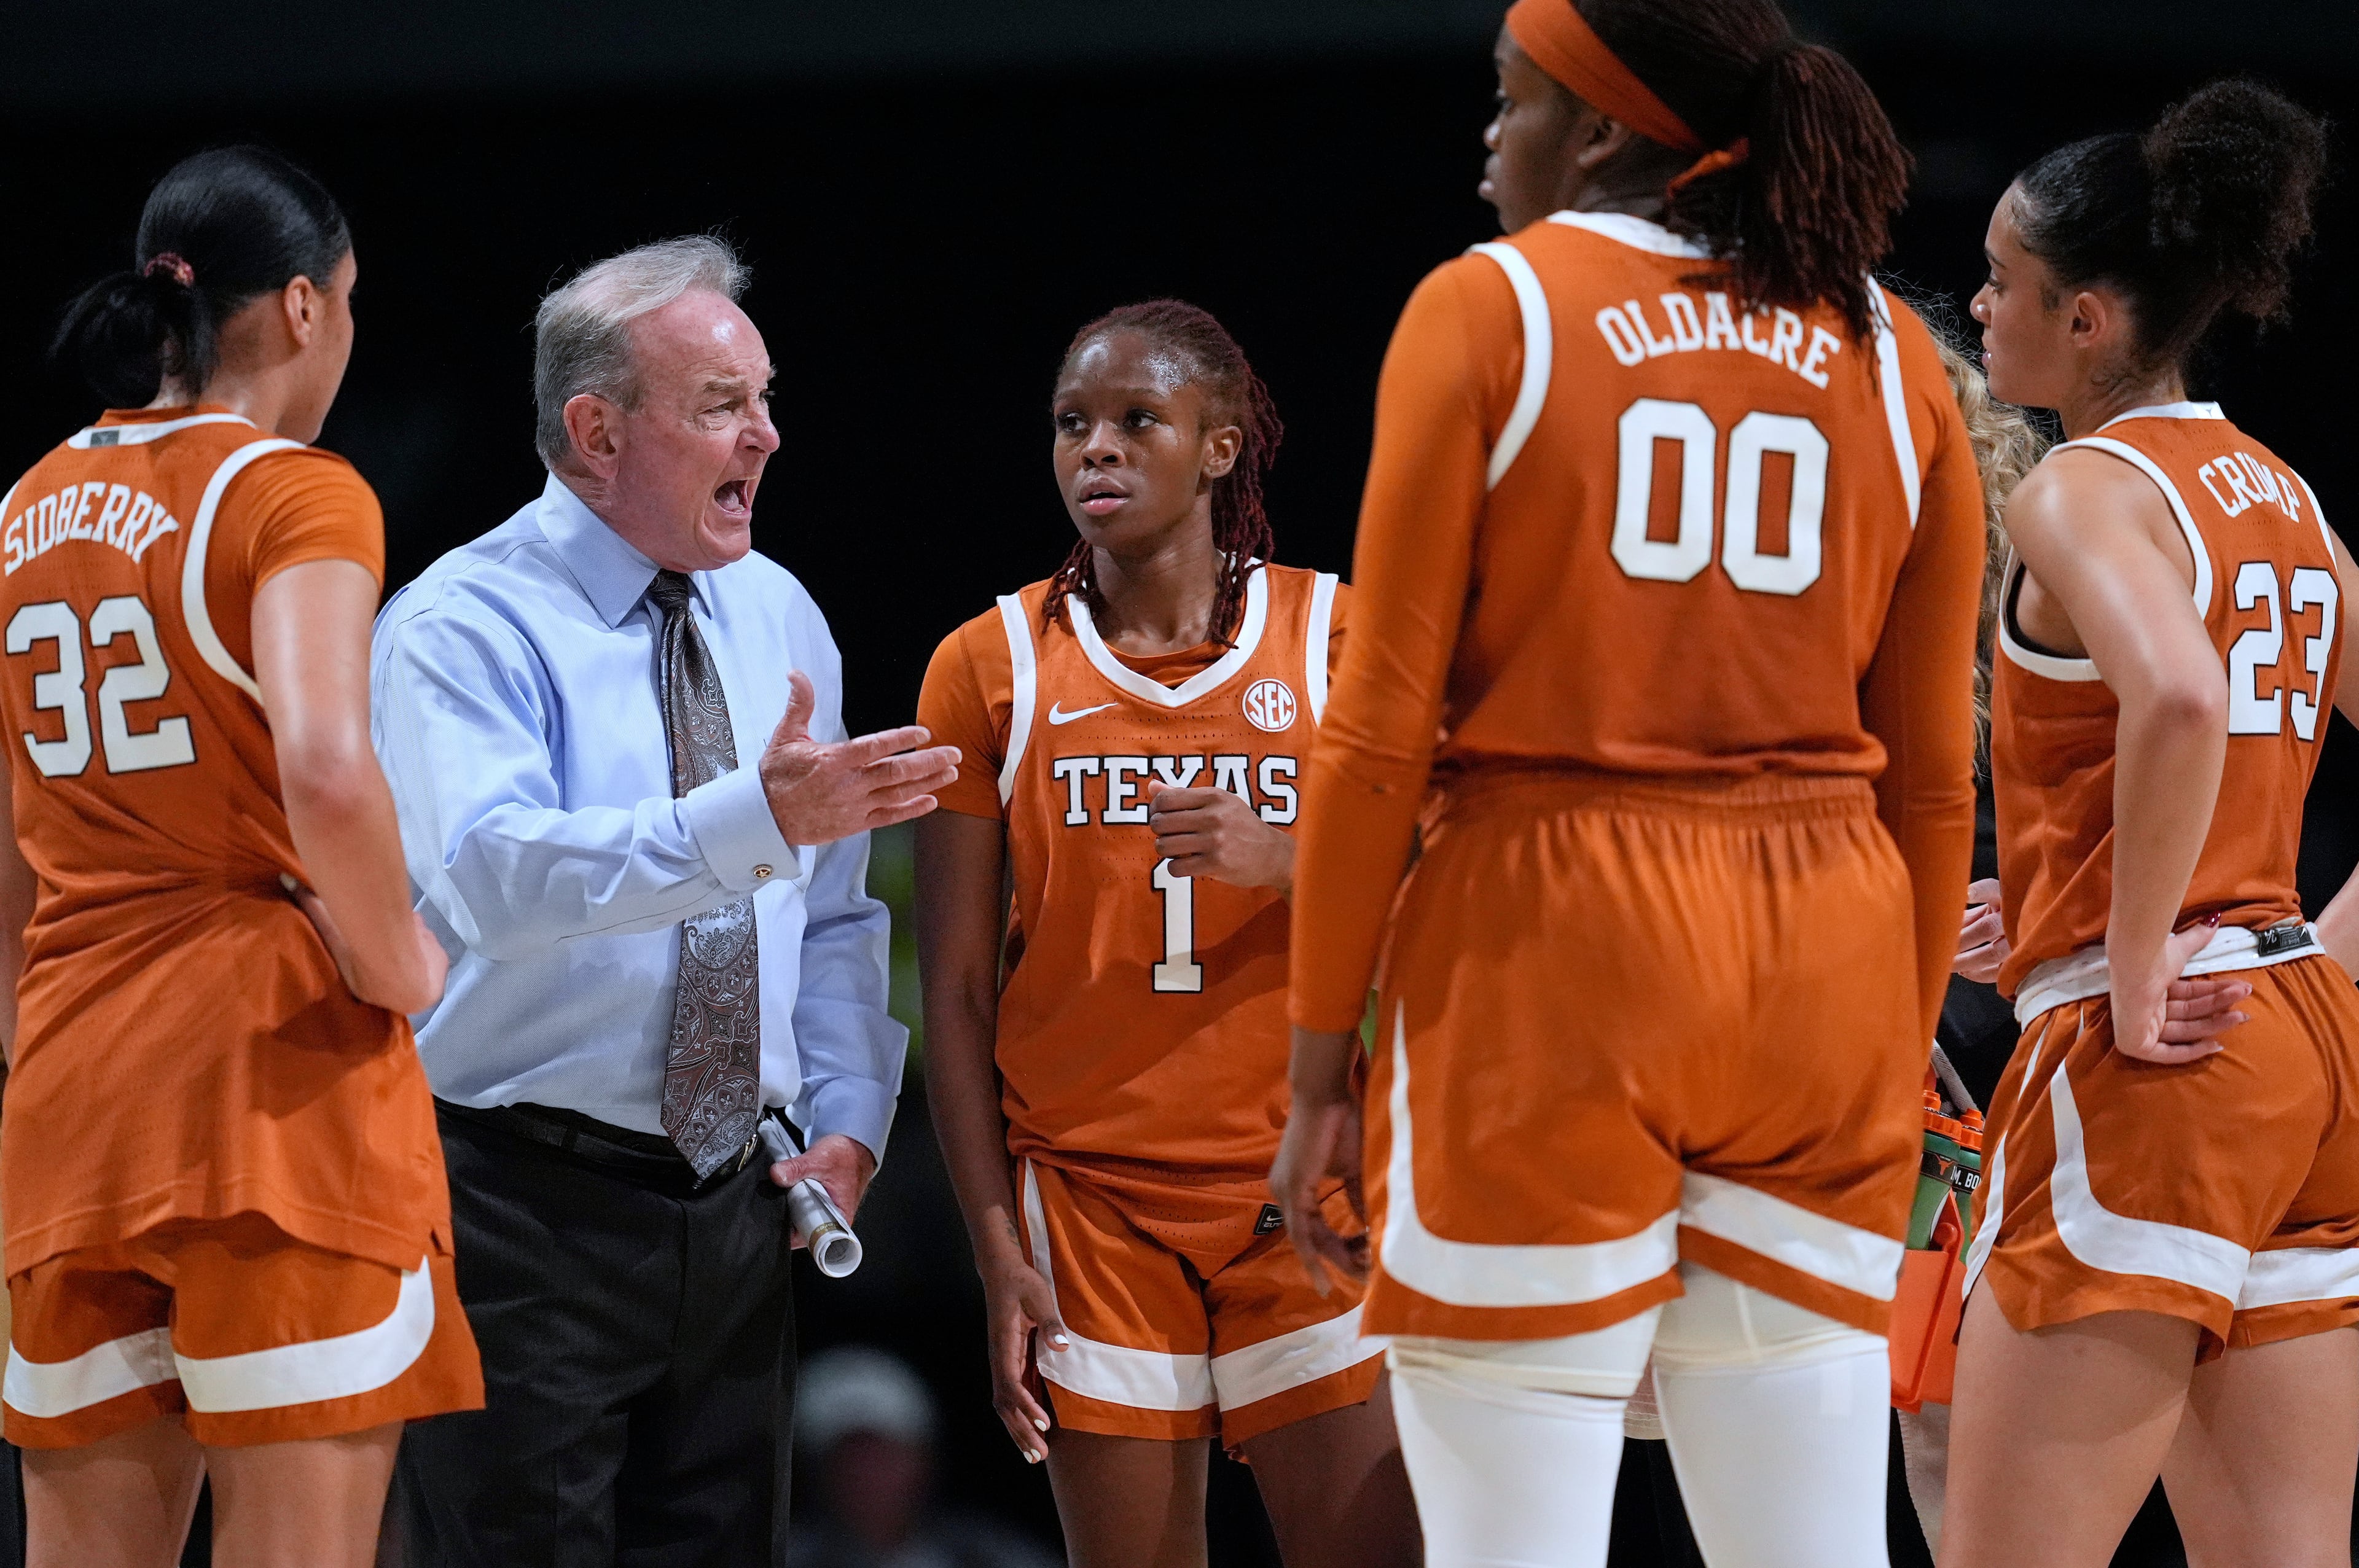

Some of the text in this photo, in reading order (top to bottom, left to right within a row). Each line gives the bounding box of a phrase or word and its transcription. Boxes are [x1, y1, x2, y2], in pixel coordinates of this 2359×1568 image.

[1595, 292, 1840, 389] OLDACRE
[4, 481, 180, 577] SIDBERRY
[1610, 396, 1830, 596] 00
[5, 595, 197, 778] 32
[1248, 682, 1293, 729] SEC
[2228, 561, 2339, 742] 23
[1151, 857, 1203, 993] 1
[1965, 1172, 1982, 1190] BO
